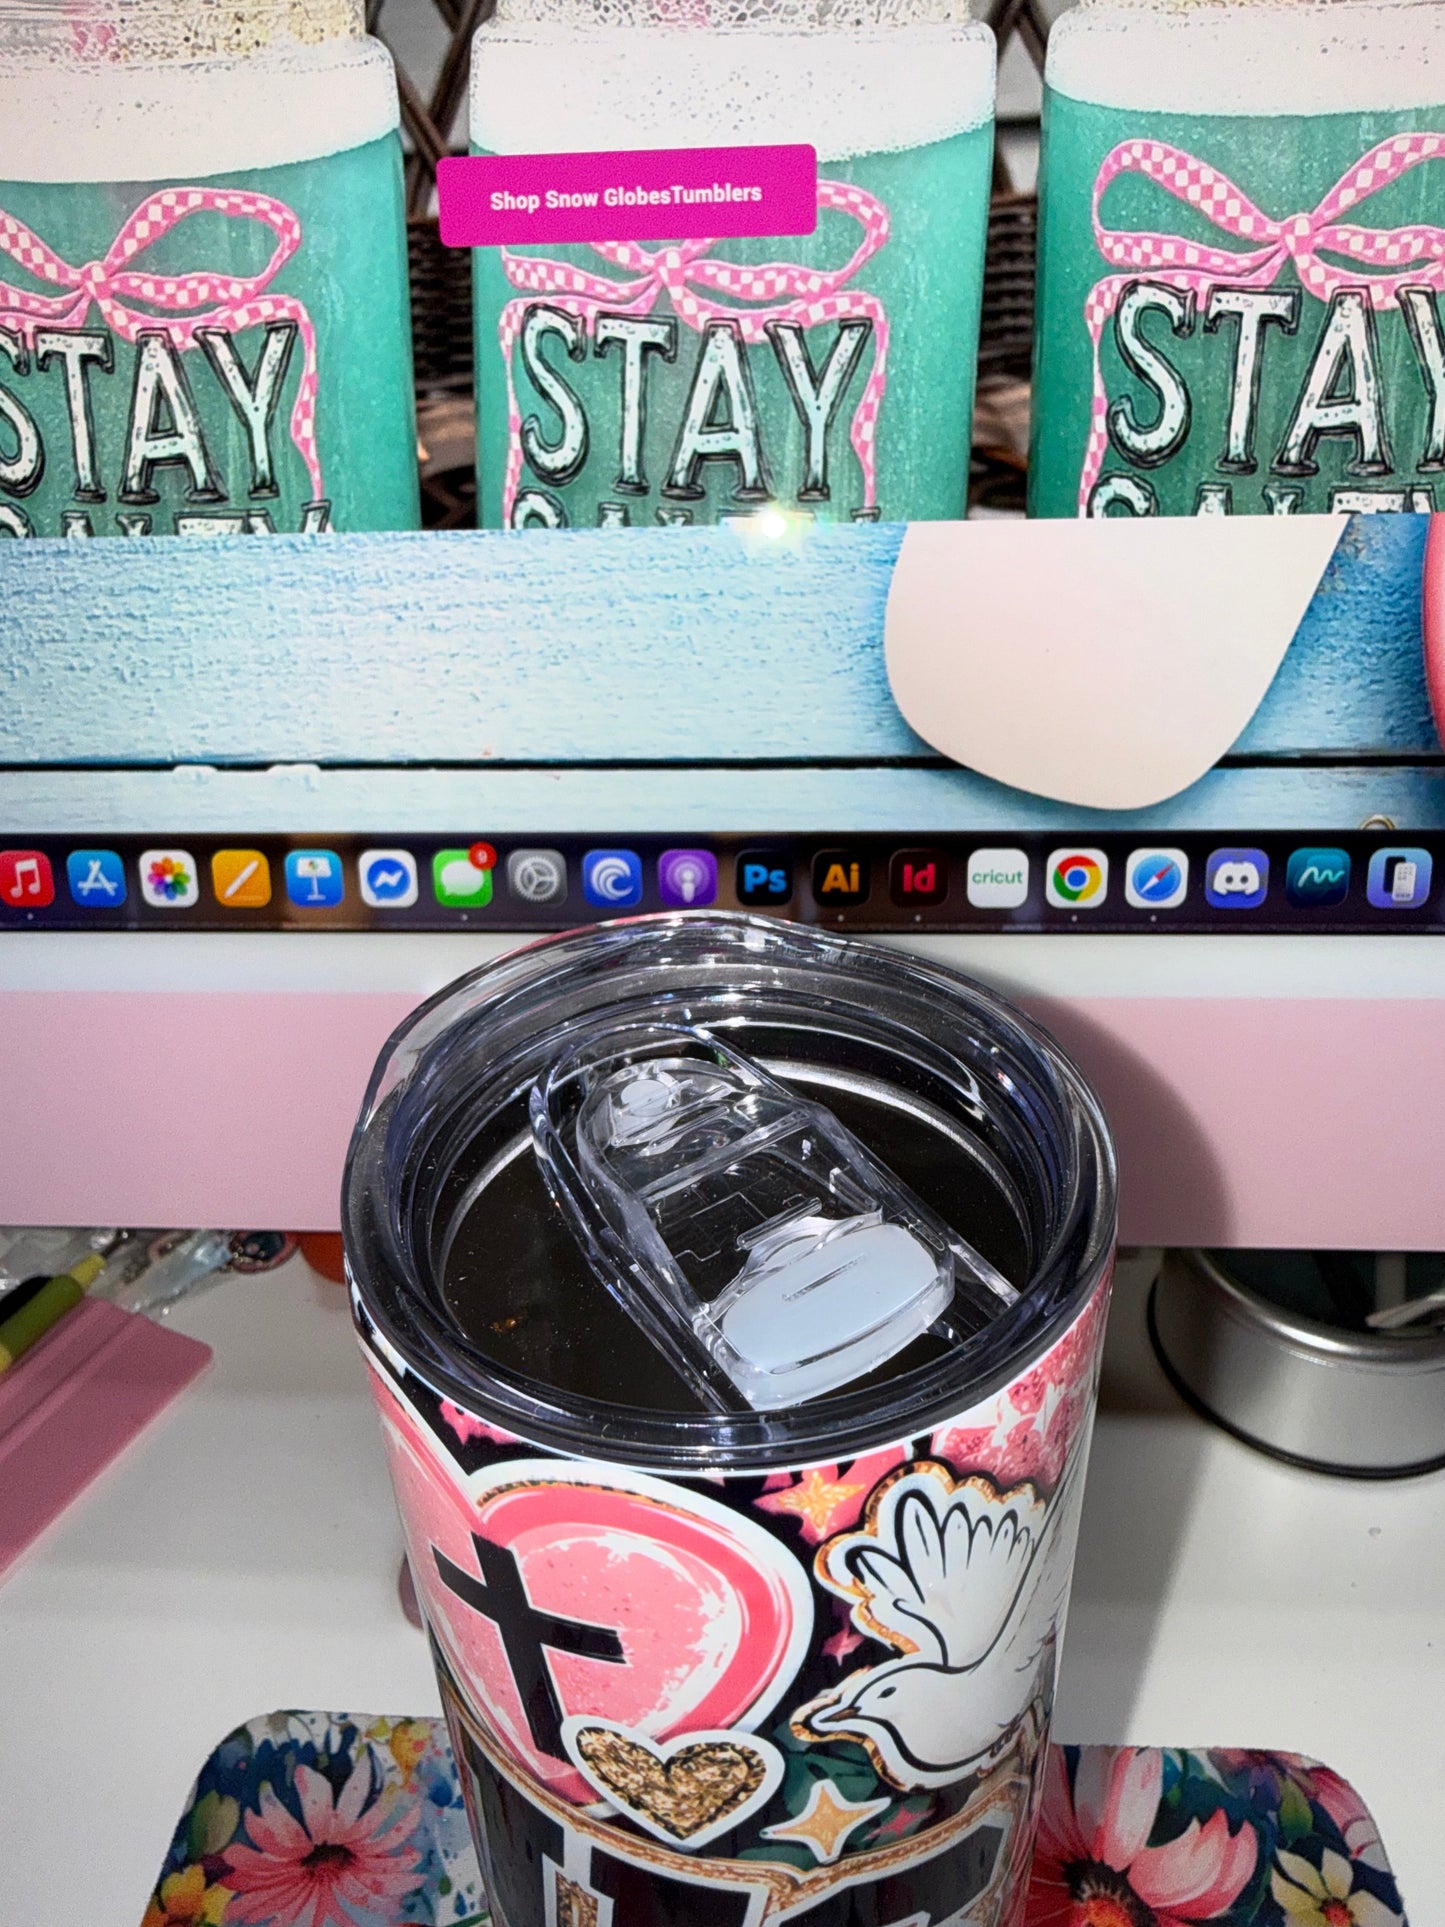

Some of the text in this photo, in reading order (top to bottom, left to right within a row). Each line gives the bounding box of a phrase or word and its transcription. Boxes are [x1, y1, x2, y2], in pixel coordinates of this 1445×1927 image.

[490, 182, 763, 214] Shop Snow GlobesTumblers
[520, 303, 873, 501] STAY
[744, 864, 787, 893] Ps
[822, 863, 860, 892] Ai
[902, 863, 936, 892] Id
[971, 869, 1023, 885] cricut
